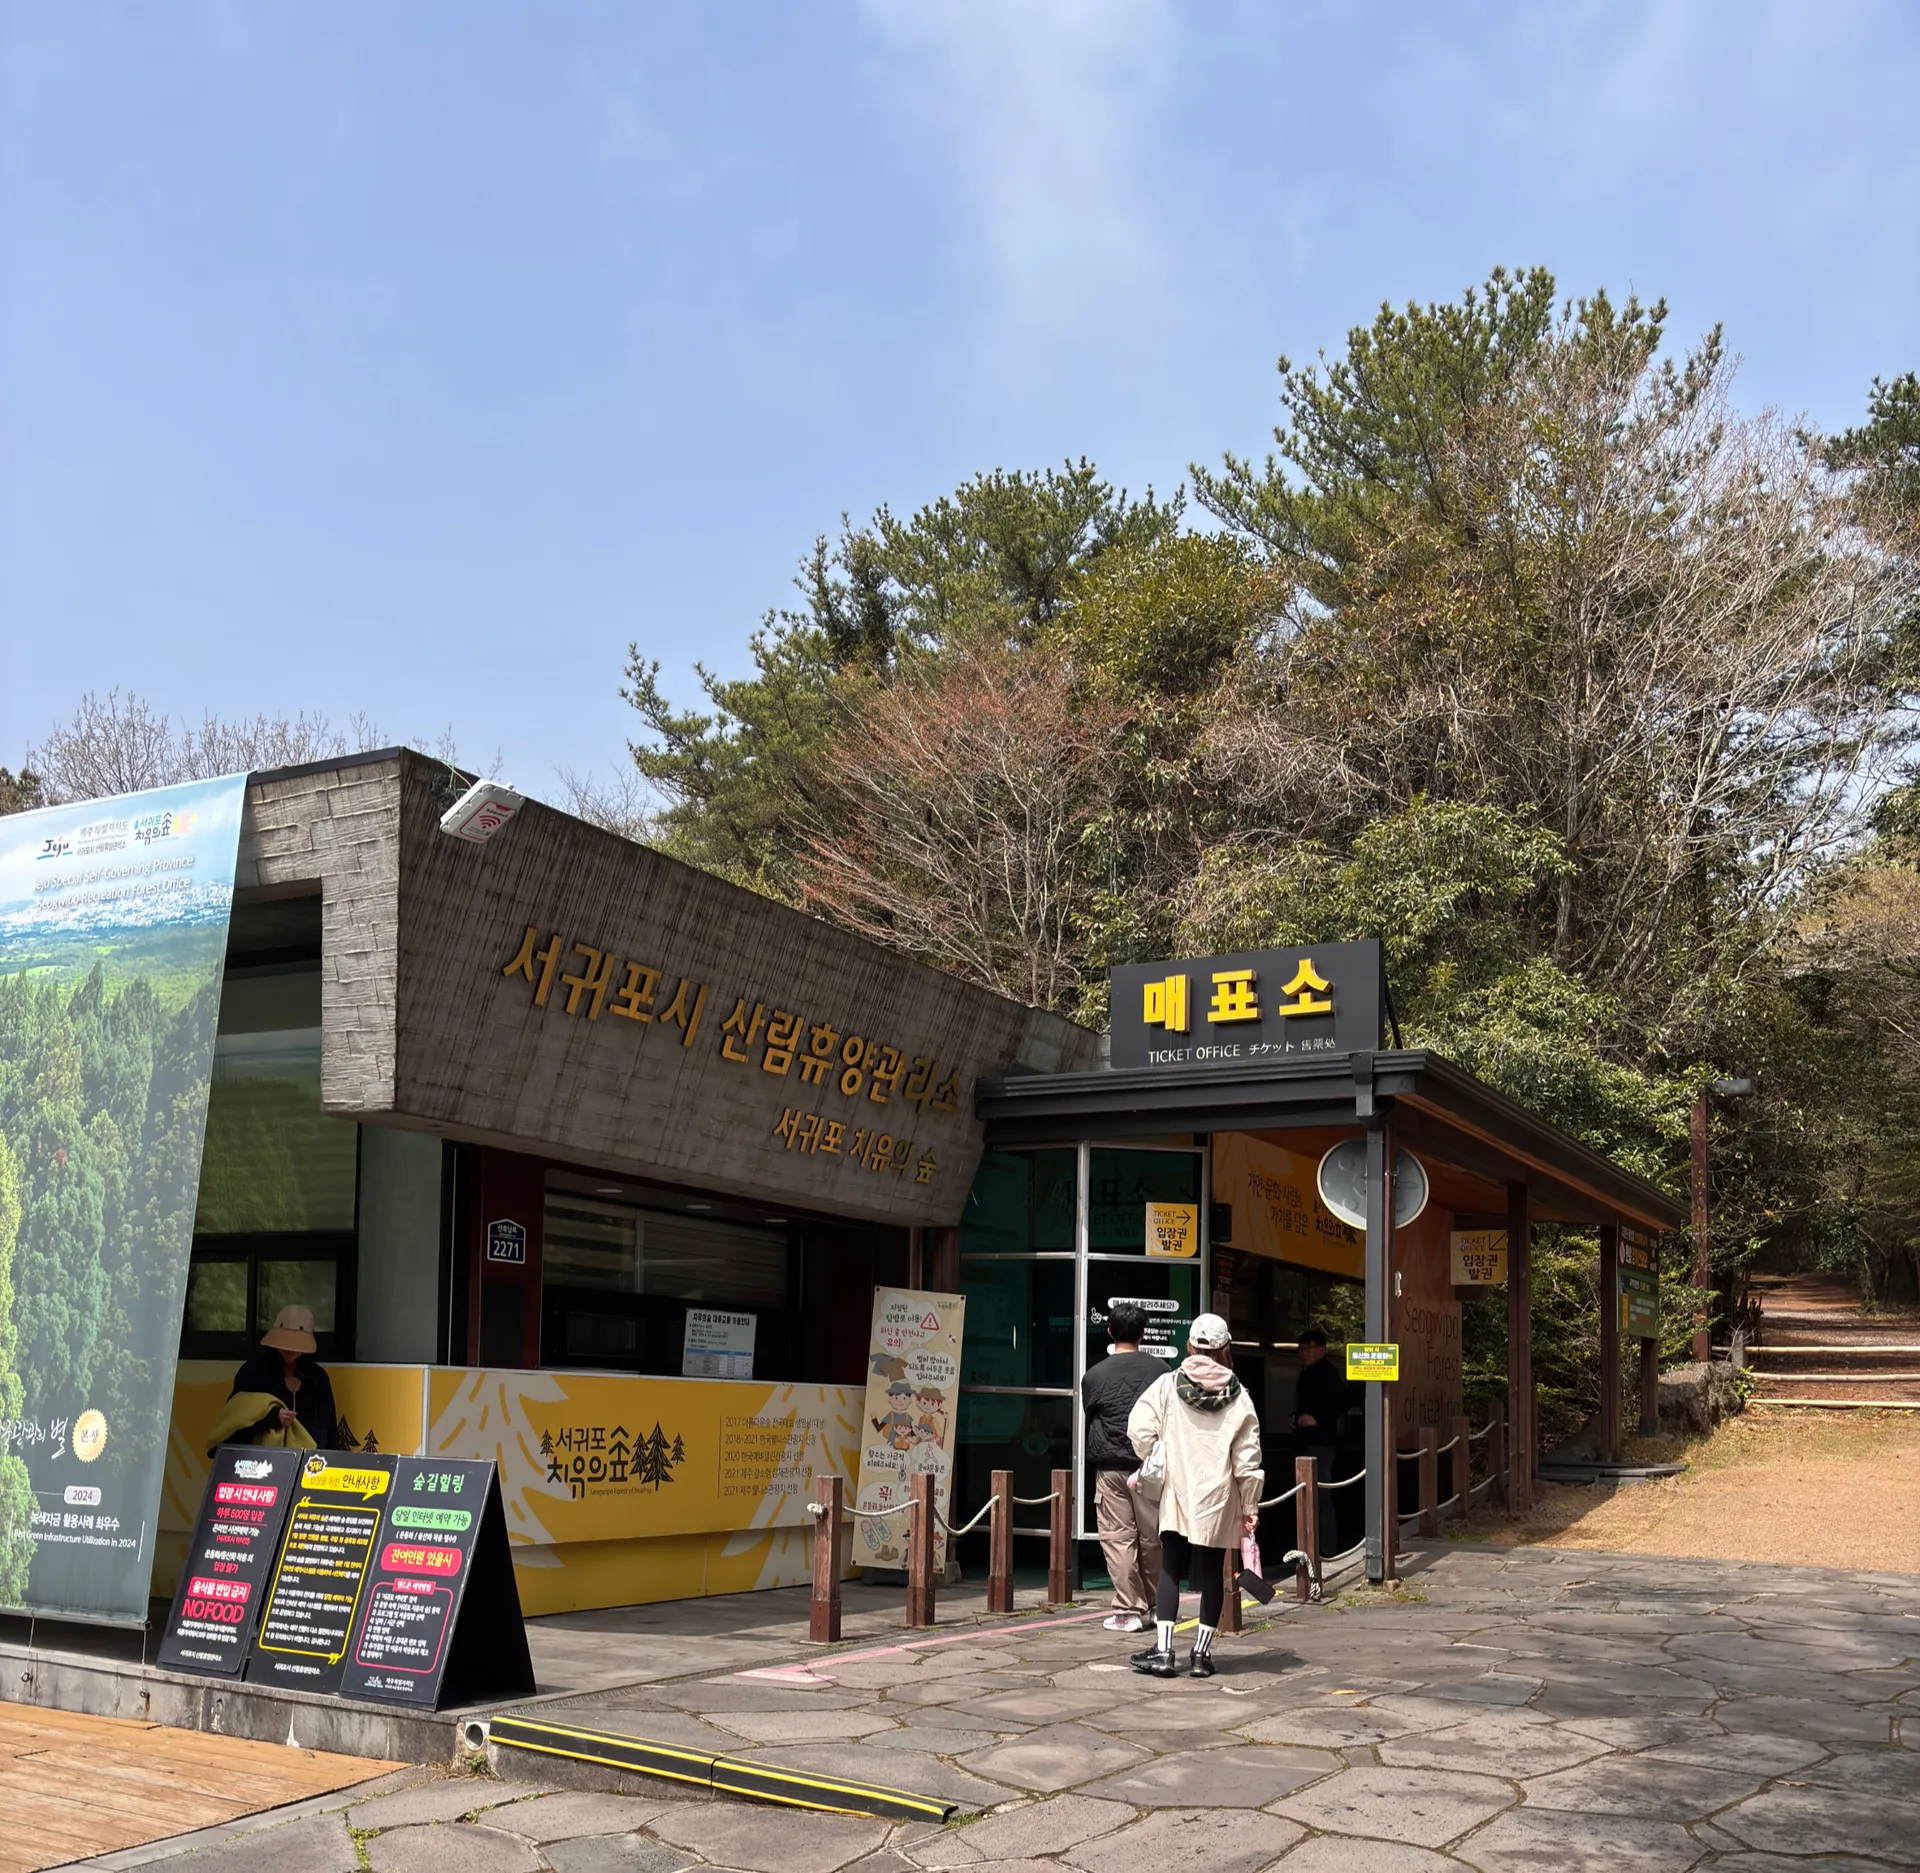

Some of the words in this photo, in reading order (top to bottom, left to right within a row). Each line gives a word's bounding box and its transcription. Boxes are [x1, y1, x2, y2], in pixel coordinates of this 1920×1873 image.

[140, 815, 162, 828] 서귀포
[42, 836, 70, 857] Jeju
[51, 871, 83, 888] Special
[84, 861, 151, 885] Self-Governing
[152, 854, 195, 870] Province
[82, 885, 129, 904] Recreation
[131, 879, 161, 897] Forest
[163, 876, 192, 891] Office
[503, 926, 709, 1049] 서귀포시
[721, 998, 965, 1114] 산림휴양관리소
[1148, 1047, 1192, 1064] TICKET
[1196, 1044, 1241, 1061] OFFICE
[1249, 1042, 1295, 1056] チケット
[773, 1107, 847, 1156] 서귀포
[849, 1127, 914, 1175] 치유의
[915, 1149, 938, 1184] 숲
[1153, 1210, 1176, 1218] TICKET
[1153, 1217, 1176, 1225] OFFICE
[1294, 1212, 1309, 1236] 담은
[1157, 1227, 1187, 1239] 입장권
[1461, 1236, 1486, 1244] TICKET
[493, 1239, 519, 1259] 2271
[1161, 1239, 1183, 1252] 발권
[1463, 1254, 1498, 1267] 입장권
[1469, 1267, 1492, 1280] 발권
[890, 1303, 908, 1313] 지정된
[692, 1312, 711, 1323] 치유의숲
[1405, 1297, 1459, 1347] Seogwipo
[1427, 1346, 1461, 1383] Forest
[1404, 1386, 1417, 1423] of
[725, 1416, 740, 1428] 2017
[555, 1427, 607, 1452] 서귀포
[725, 1433, 758, 1445] 2018-2021
[725, 1450, 740, 1461] 2020
[724, 1468, 739, 1479] 2021
[741, 1468, 754, 1479] 제주
[801, 1466, 813, 1478] 선정
[342, 1474, 380, 1491] 안내사항
[413, 1471, 465, 1493] 숲길힐링
[629, 1486, 635, 1494] of
[723, 1486, 738, 1496] 2021
[787, 1483, 798, 1495] 선정
[72, 1490, 93, 1501] 2024
[219, 1486, 234, 1500] 입장
[233, 1487, 243, 1501] 시
[242, 1488, 259, 1502] 안내
[258, 1489, 275, 1503] 사항
[878, 1486, 892, 1501] 꼭!
[95, 1515, 120, 1531] 최우수
[251, 1510, 265, 1522] 입장
[395, 1510, 410, 1522] 당일
[412, 1511, 434, 1524] 인터넷
[435, 1512, 452, 1526] 예약
[453, 1514, 469, 1527] 가능
[26, 1531, 44, 1540] Green
[44, 1531, 82, 1544] Infrastructure
[82, 1535, 111, 1547] Utilization
[111, 1537, 118, 1546] in
[118, 1538, 137, 1548] 2024
[391, 1548, 426, 1566] 잔여인원
[192, 1580, 216, 1596] 음식물
[215, 1582, 232, 1598] 반입
[230, 1584, 248, 1600] 금지
